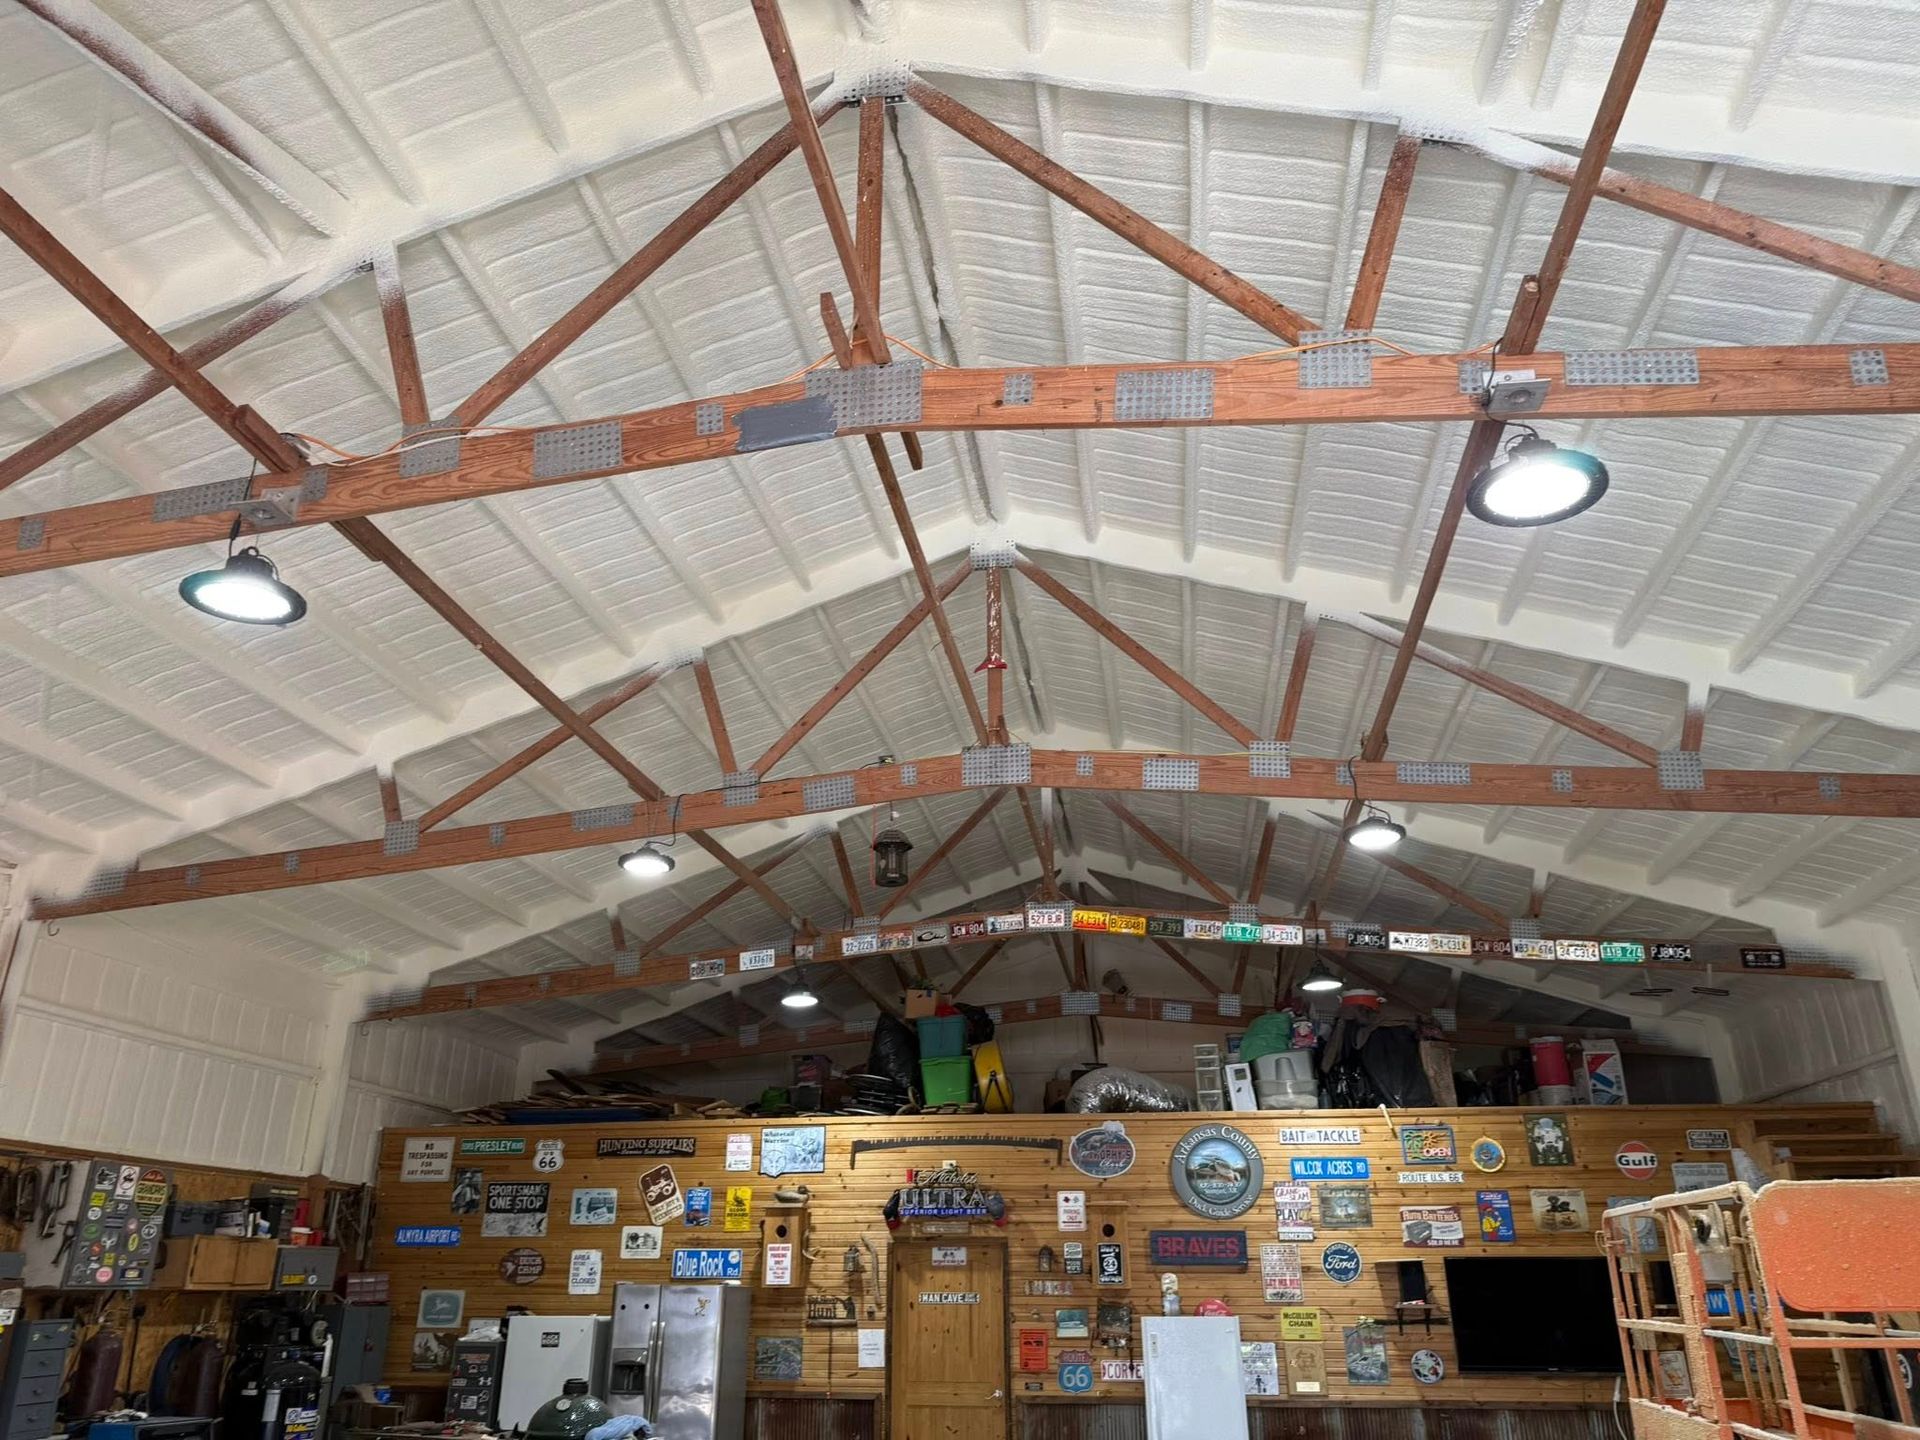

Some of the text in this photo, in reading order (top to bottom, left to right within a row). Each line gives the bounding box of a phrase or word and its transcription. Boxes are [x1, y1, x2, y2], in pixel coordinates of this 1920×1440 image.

[1030, 914, 1047, 925] 527
[968, 920, 985, 934] 804
[1493, 942, 1511, 954] 804
[1281, 1130, 1305, 1145] BAIT
[1316, 1130, 1359, 1144] TACKLE
[424, 1143, 435, 1151] NO
[474, 1140, 512, 1152] PRESLEY
[599, 1138, 695, 1154] HUNTING SUPPLIES
[1174, 1125, 1261, 1163] Arkansas County
[407, 1152, 449, 1160] TRESPASSING
[1423, 1147, 1453, 1158] OPEN
[539, 1156, 557, 1169] 66
[1617, 1154, 1657, 1168] Gulf
[420, 1168, 445, 1177] PURPOSE
[1293, 1160, 1366, 1176] WILCOX ACRES RD
[1401, 1172, 1461, 1183] ROUTE U.S. 66
[488, 1196, 545, 1210] ONE STOP
[899, 1187, 987, 1209] ULTRA
[898, 1208, 988, 1217] SUPERIOR LIGHT BEER
[1276, 1208, 1299, 1221] PLAY
[1401, 1210, 1461, 1222] AUTO BATTERIES
[396, 1229, 425, 1244] ALMYRA
[425, 1229, 451, 1244] AIRPORT
[1157, 1235, 1240, 1258] BRAVES
[675, 1251, 740, 1278] Blue Rock Rd
[1105, 1259, 1117, 1269] 24
[1324, 1254, 1358, 1270] Ford
[517, 1265, 543, 1275] CAMP
[921, 1292, 941, 1303] MAN
[942, 1292, 964, 1303] CAVE
[1282, 1312, 1318, 1321] McCULLOCH
[1288, 1319, 1314, 1328] CHAIN
[1063, 1353, 1088, 1362] ROUTE
[1063, 1365, 1089, 1388] 66
